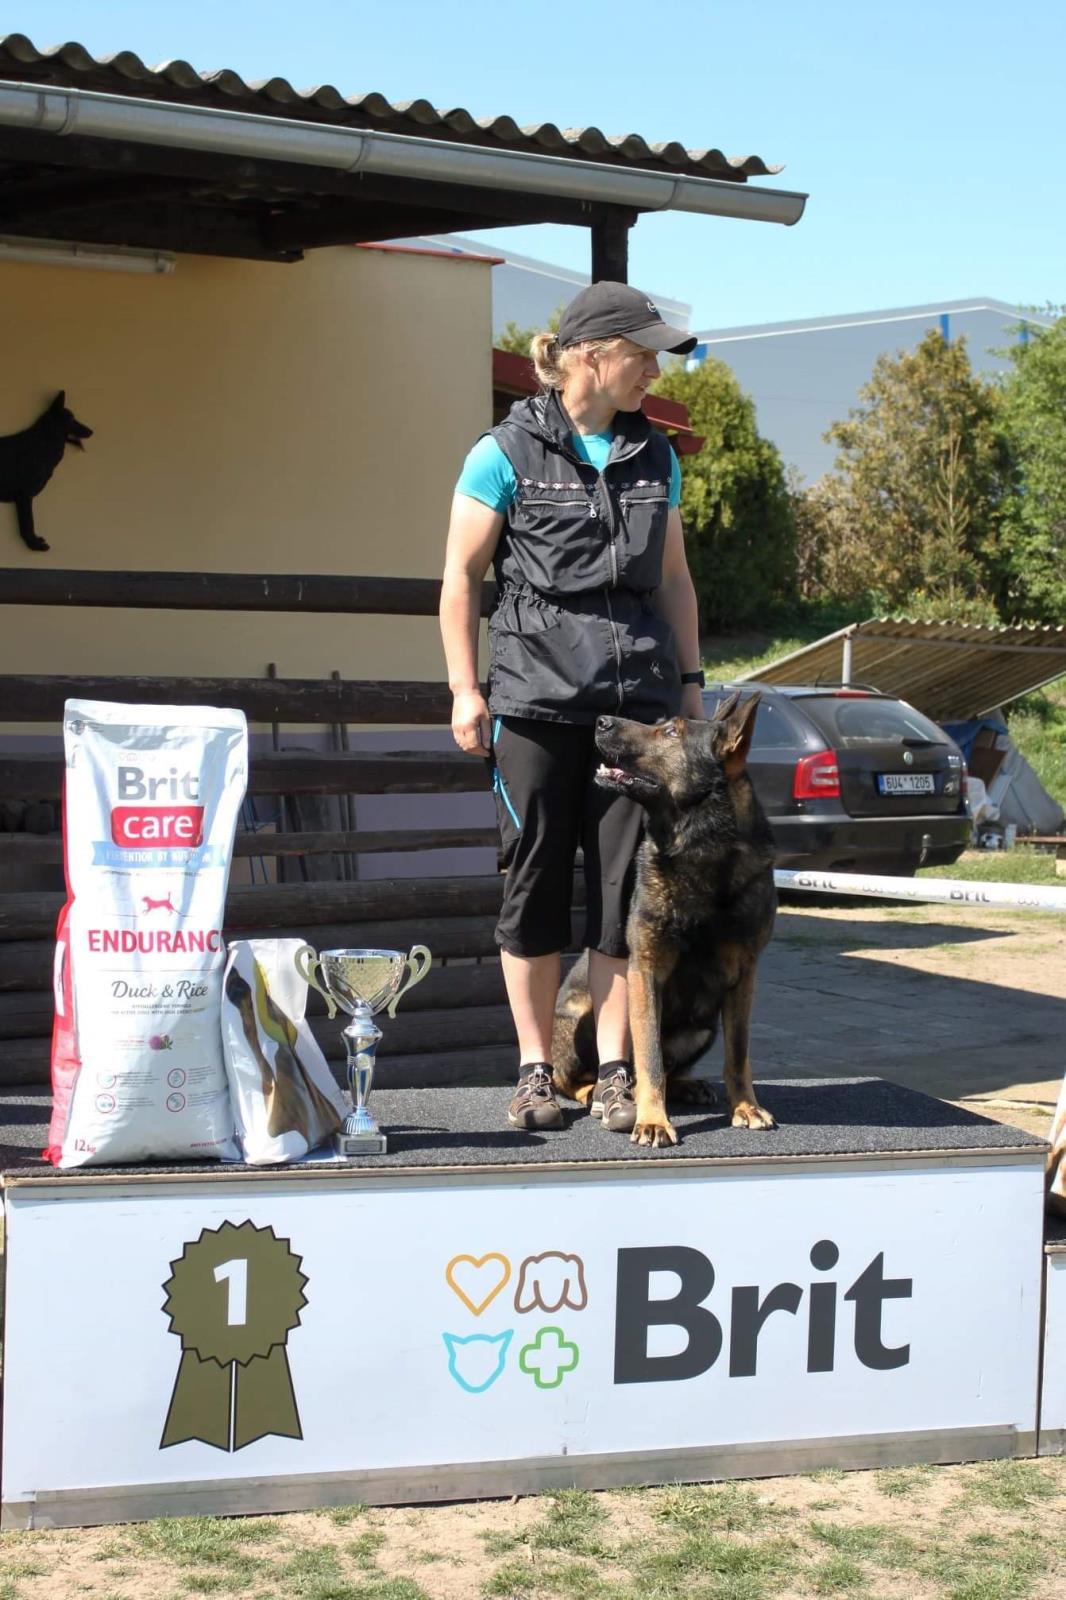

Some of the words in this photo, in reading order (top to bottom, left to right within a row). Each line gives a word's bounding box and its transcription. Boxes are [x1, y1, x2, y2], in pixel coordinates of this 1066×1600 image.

[117, 766, 200, 801] Brit
[123, 814, 194, 839] care
[88, 929, 222, 953] ENDURANC
[111, 980, 158, 998] Duck
[161, 984, 174, 998] &
[176, 980, 208, 1000] Rice
[214, 1259, 247, 1325] 1
[614, 1240, 912, 1384] Brit
